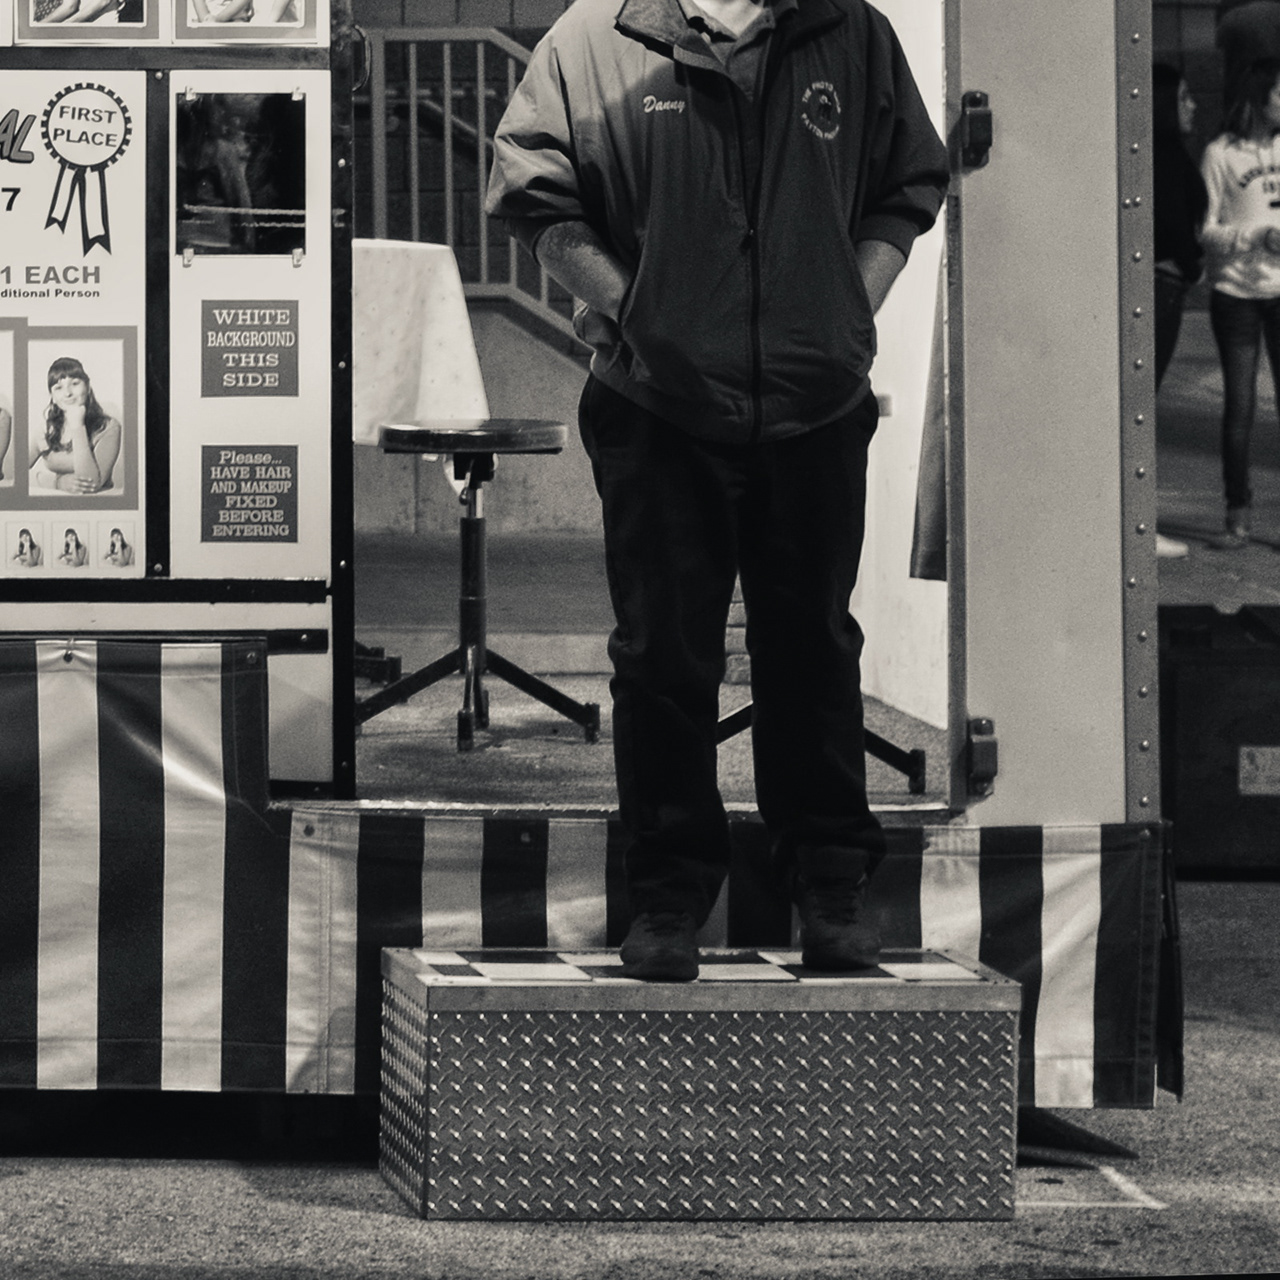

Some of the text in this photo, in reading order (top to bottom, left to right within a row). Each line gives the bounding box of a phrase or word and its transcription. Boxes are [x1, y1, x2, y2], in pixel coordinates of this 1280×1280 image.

[642, 94, 687, 115] Danny
[58, 105, 118, 125] FIRST
[52, 127, 118, 148] PLACE
[25, 265, 101, 285] EACH
[55, 289, 100, 299] Person
[213, 309, 290, 325] WHITE
[207, 331, 296, 348] BACKGROUND
[222, 353, 280, 367] THIS
[222, 373, 280, 387] SIDE
[210, 466, 292, 479] HAVE HAIR
[210, 480, 292, 494] AND MAKEUP
[225, 495, 278, 508] FIXED
[218, 509, 284, 523] BEFORE
[212, 524, 290, 537] ENTERING
